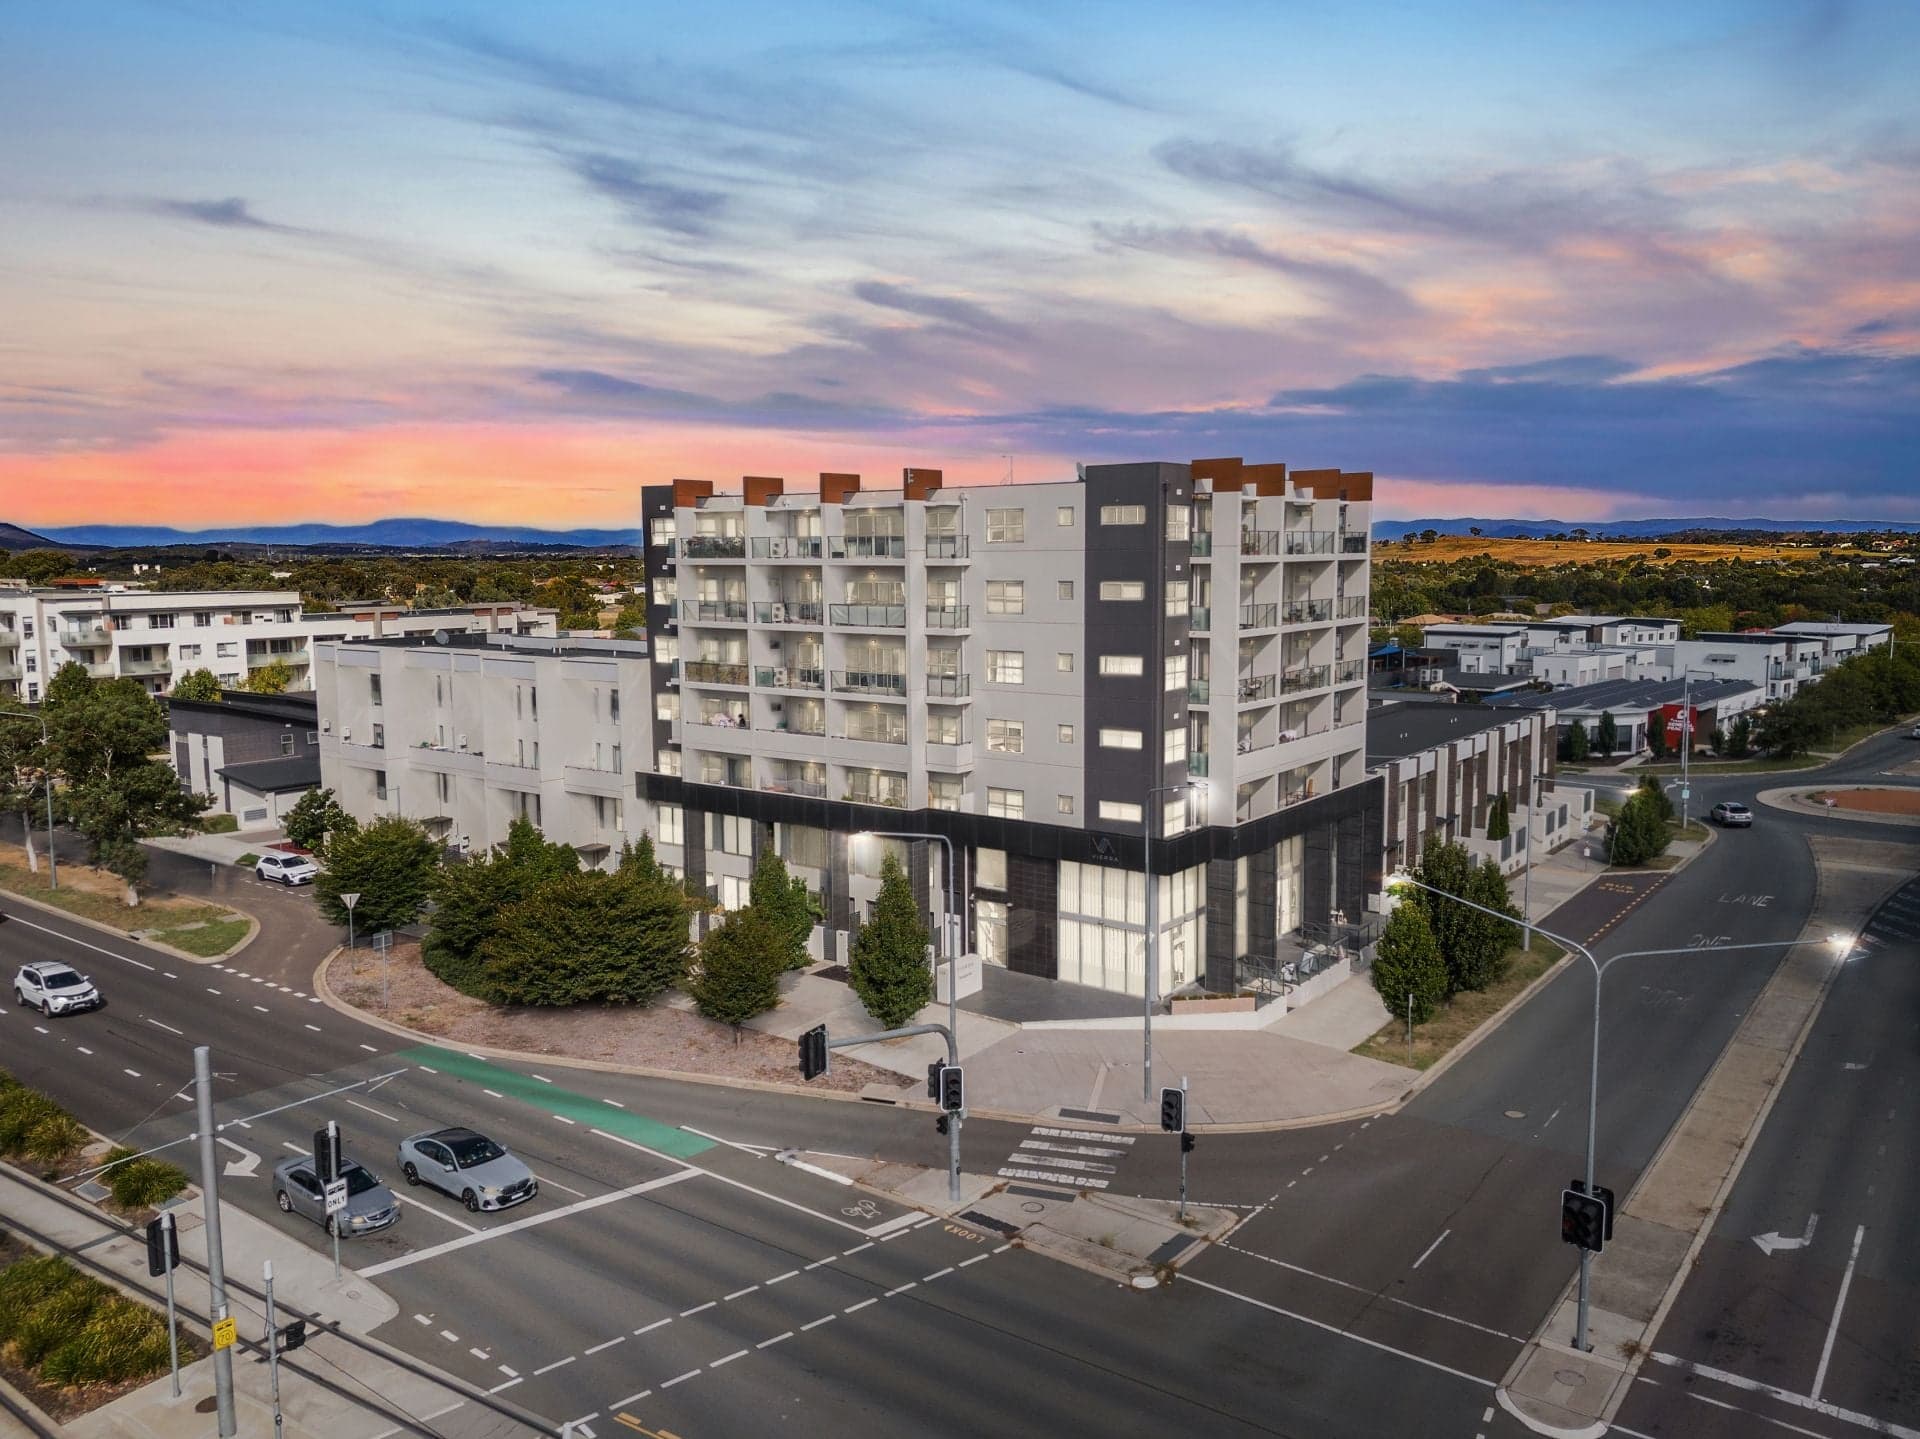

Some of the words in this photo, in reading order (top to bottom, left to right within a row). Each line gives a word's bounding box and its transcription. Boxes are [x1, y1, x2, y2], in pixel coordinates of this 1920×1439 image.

[1718, 893, 1775, 907] LANE
[328, 1196, 345, 1208] ONLY
[949, 1226, 985, 1243] LOOK
[219, 1332, 231, 1343] 70
